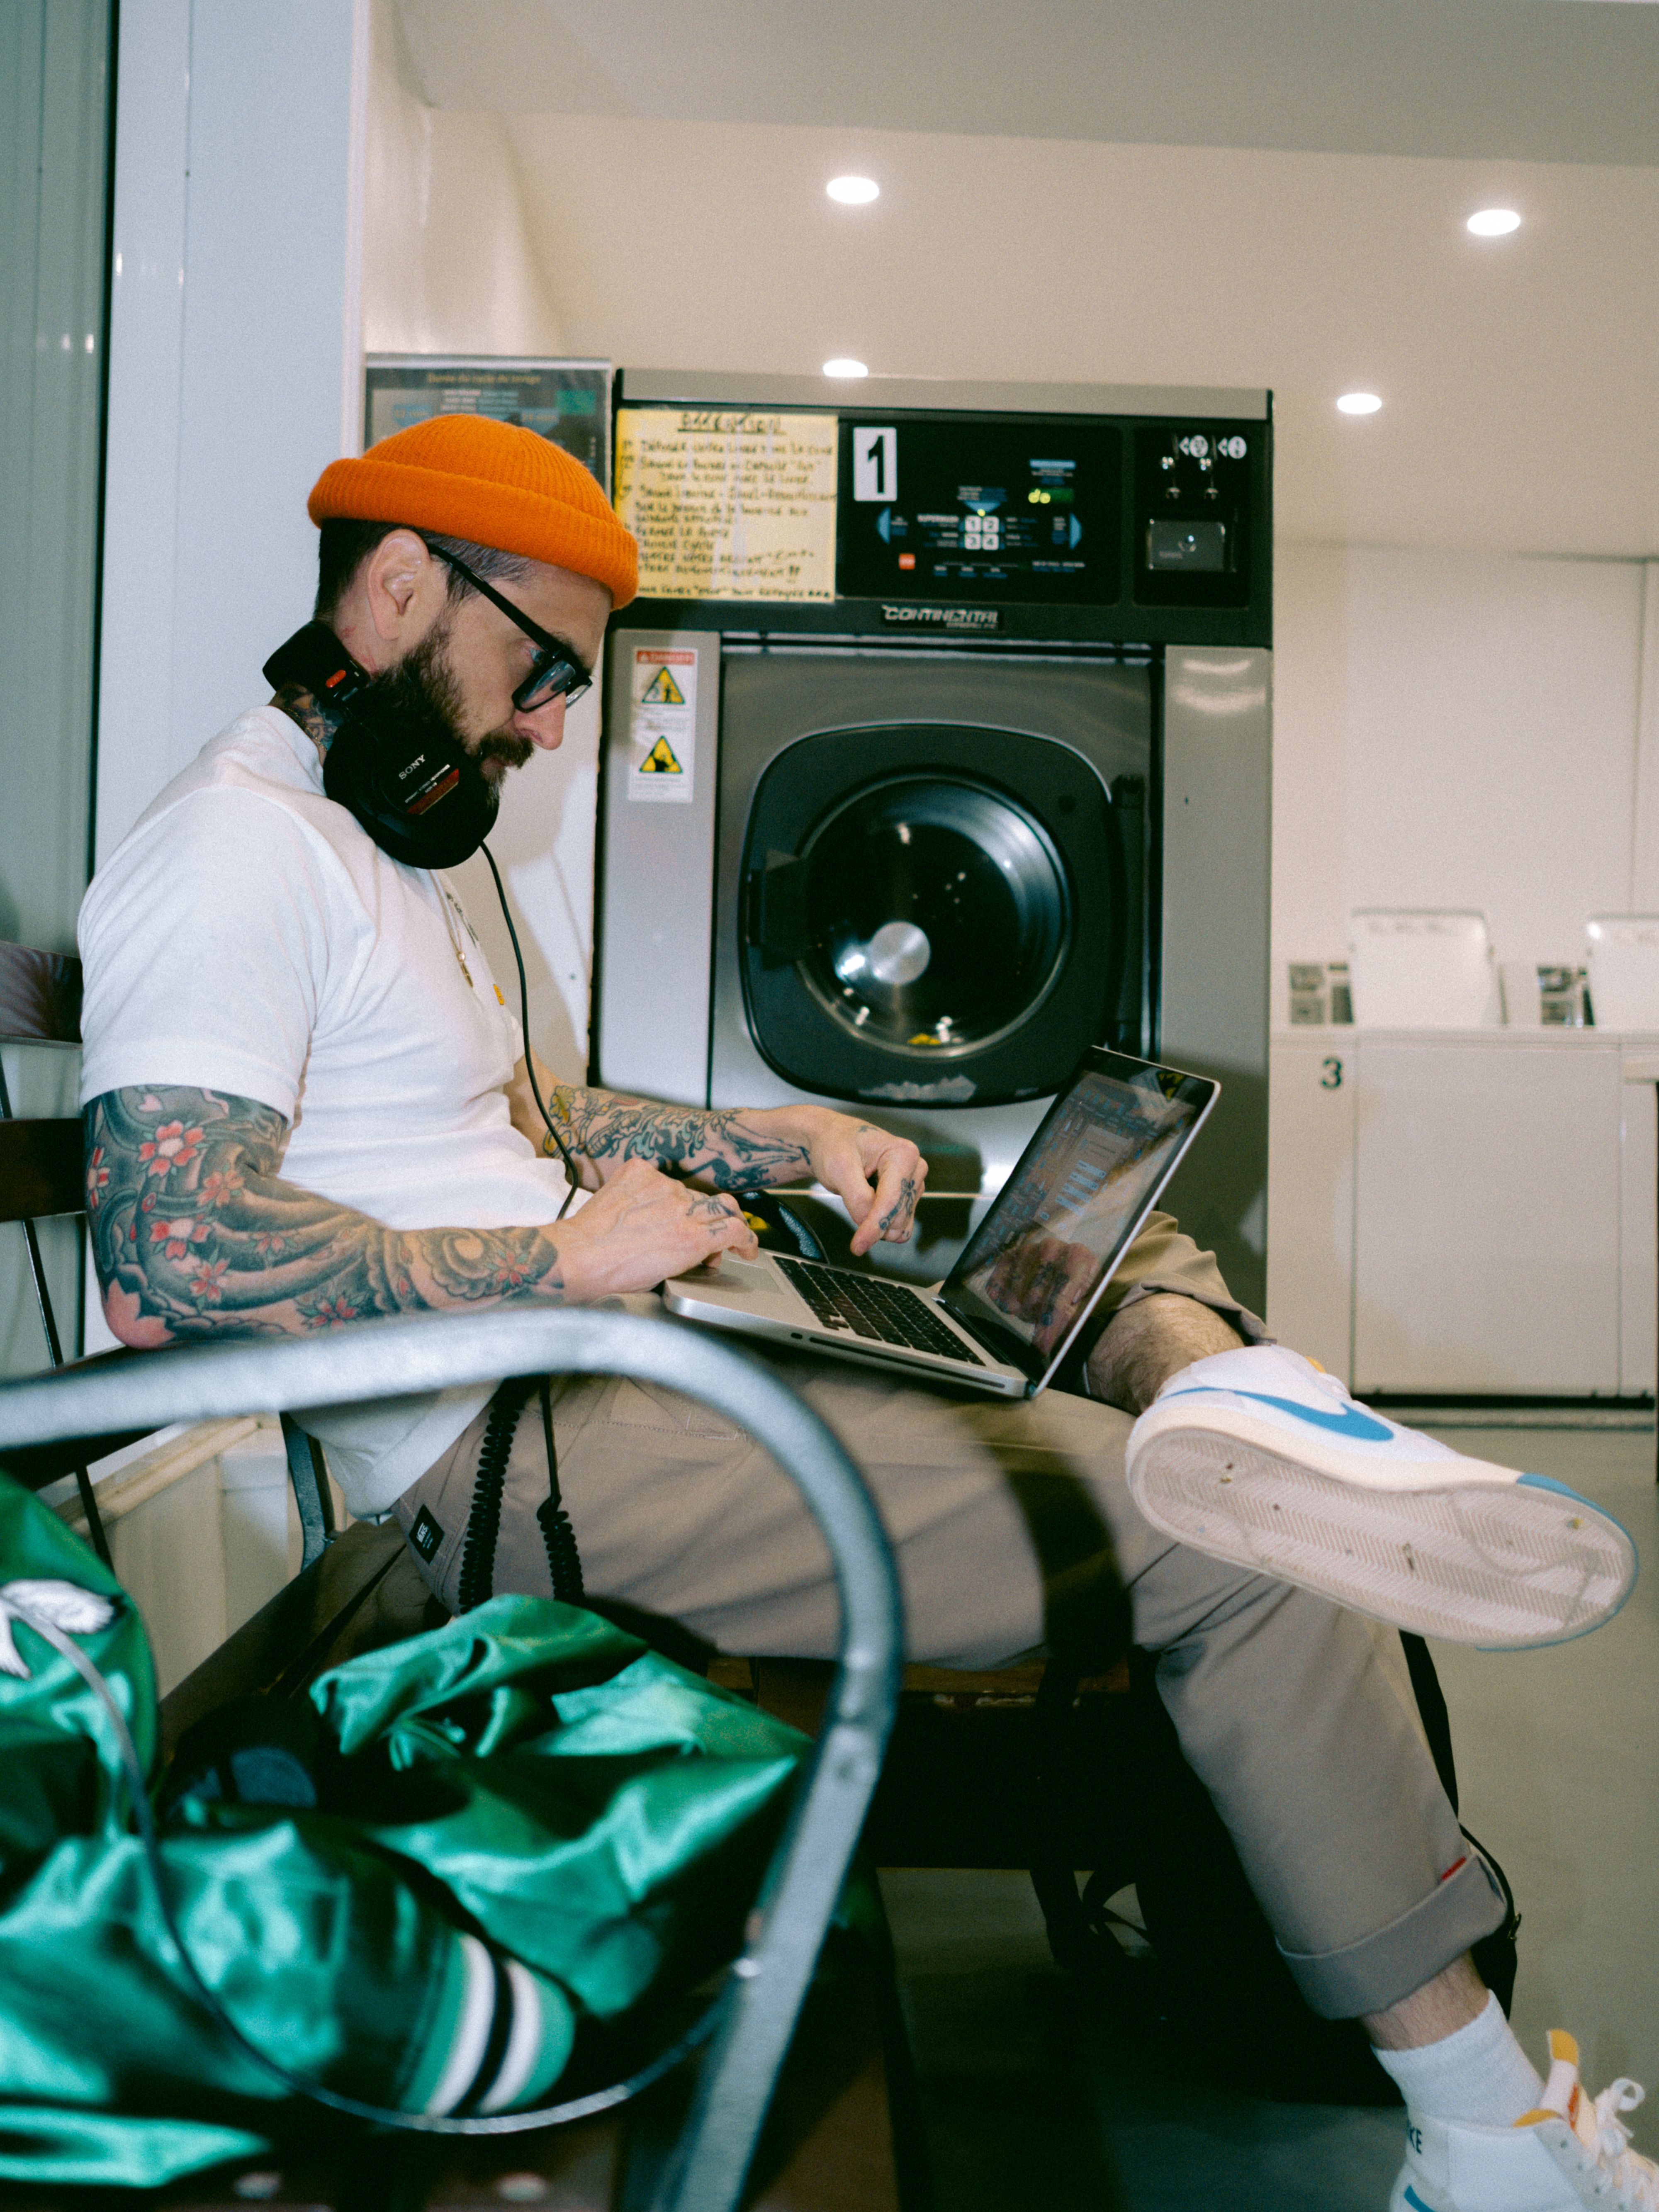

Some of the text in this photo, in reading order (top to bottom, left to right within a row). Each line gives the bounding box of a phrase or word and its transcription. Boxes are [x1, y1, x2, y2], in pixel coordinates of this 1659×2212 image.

[868, 435, 885, 494] 1
[399, 754, 426, 780] SONY
[1321, 1058, 1342, 1090] 3
